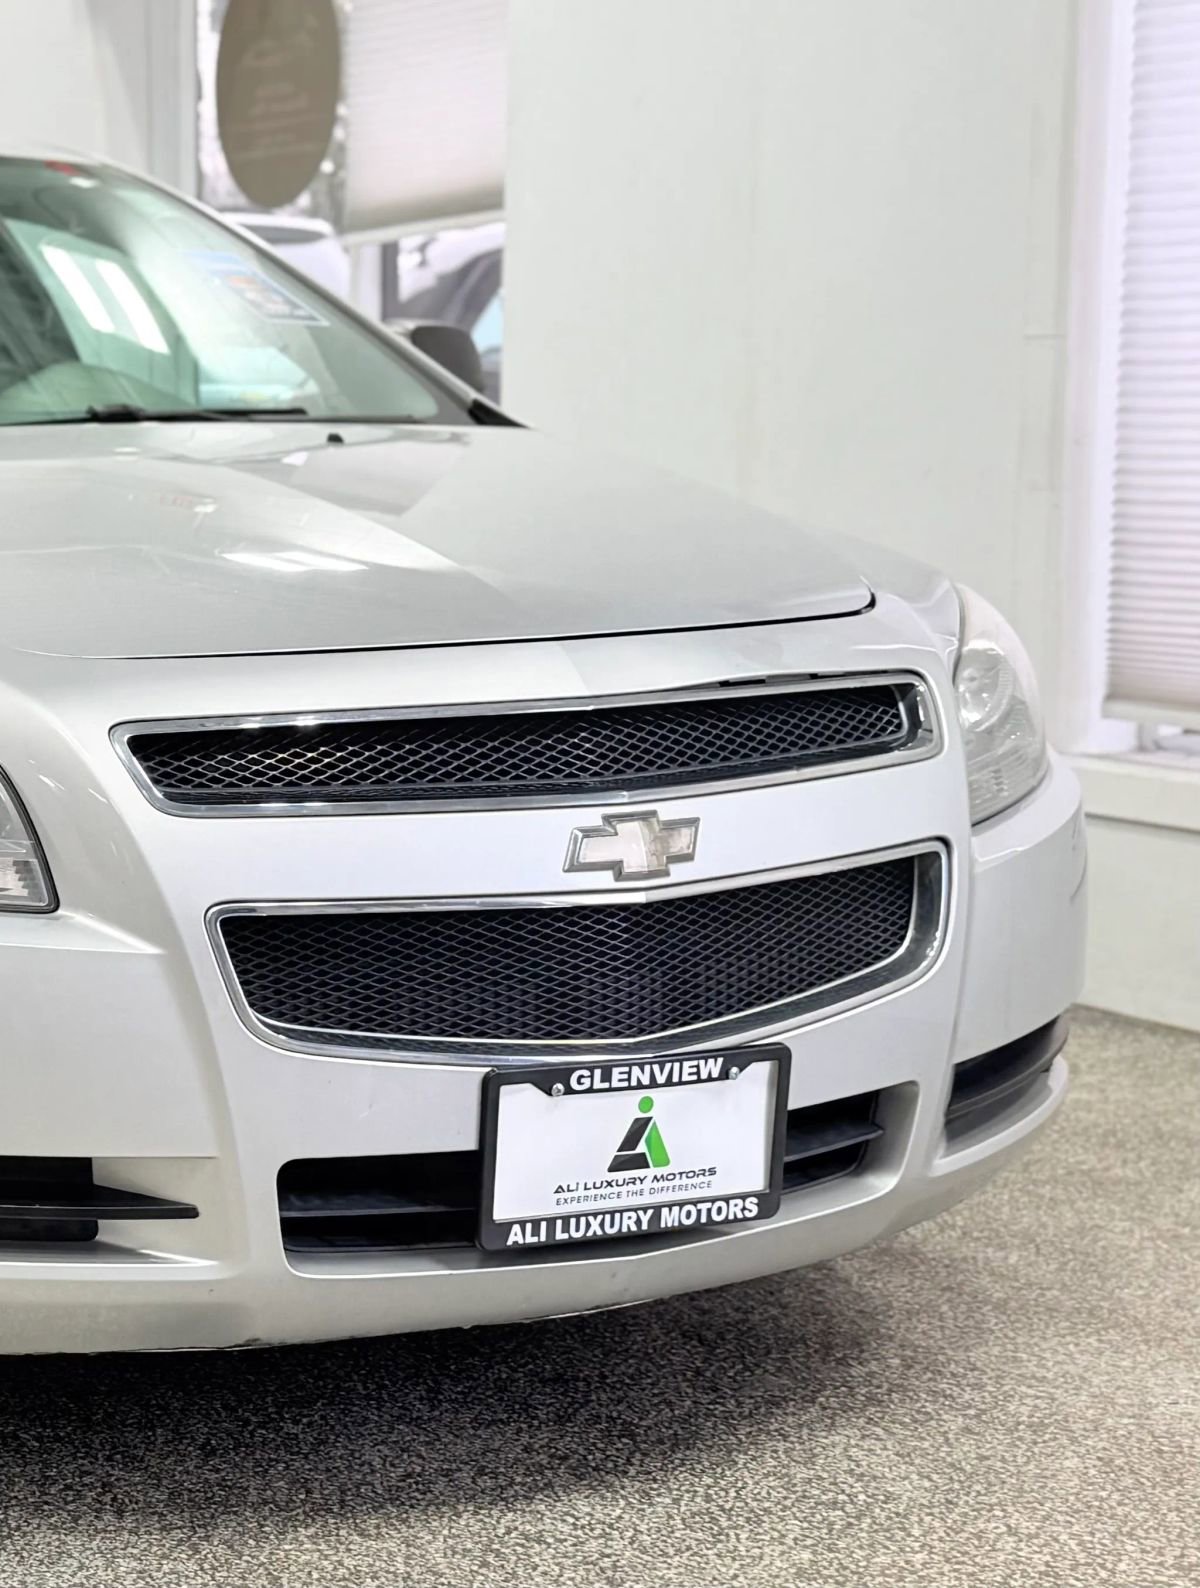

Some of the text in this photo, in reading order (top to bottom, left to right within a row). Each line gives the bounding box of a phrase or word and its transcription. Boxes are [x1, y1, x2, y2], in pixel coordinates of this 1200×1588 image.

[569, 1057, 724, 1091] GLENVIEW
[583, 1175, 648, 1191] LUXURY
[651, 1166, 717, 1183] MOTORS
[555, 1181, 713, 1206] EXPERIENCE THE DIFFERENCE
[506, 1196, 759, 1246] ALI LUXURY MOTORS
